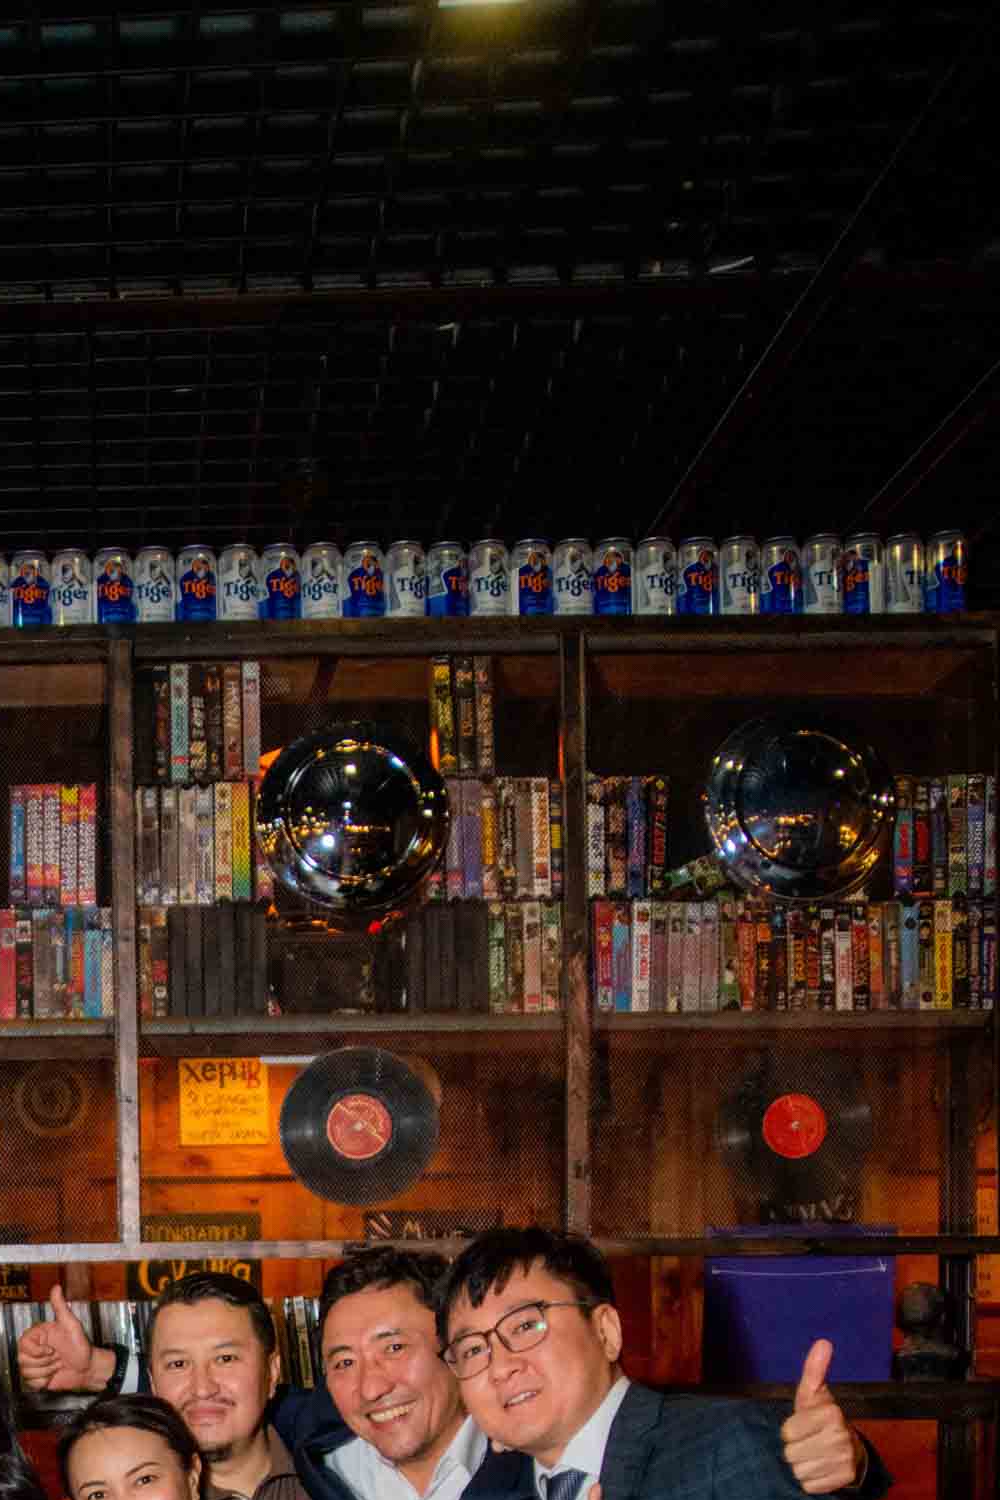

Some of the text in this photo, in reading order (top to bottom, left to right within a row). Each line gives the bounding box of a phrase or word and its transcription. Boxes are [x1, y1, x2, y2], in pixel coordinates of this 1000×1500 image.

[51, 584, 90, 607] Tiger
[302, 577, 338, 601] Tiger
[397, 575, 426, 600] Tig
[647, 572, 676, 596] Tig
